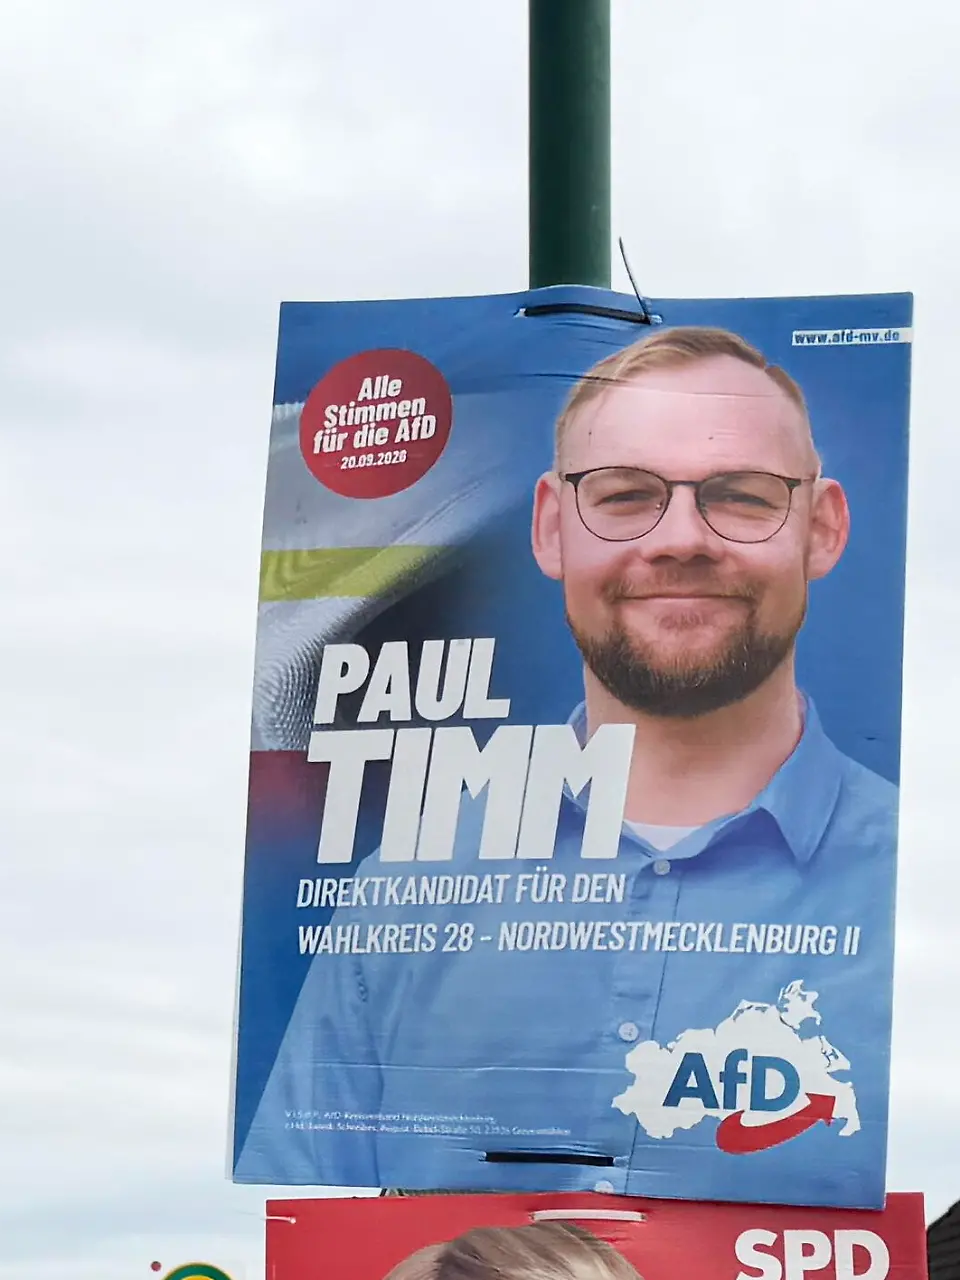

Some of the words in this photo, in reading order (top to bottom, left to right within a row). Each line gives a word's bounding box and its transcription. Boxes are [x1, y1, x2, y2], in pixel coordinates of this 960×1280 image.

[358, 374, 402, 401] Alle
[323, 397, 426, 429] Stimmen
[313, 428, 349, 454] für
[353, 423, 389, 448] die
[394, 414, 437, 443] AfD
[313, 637, 511, 725] PAUL
[307, 723, 637, 864] TIMM
[296, 874, 511, 907] DIREKTKANDIDAT
[515, 866, 567, 903] FÜR
[571, 873, 626, 903] DEN
[298, 923, 438, 954] WAHLKREIS
[442, 923, 475, 952] 28
[498, 921, 839, 955] NORDWESTMECKLENBURG
[843, 926, 861, 955] II
[662, 1048, 801, 1112] AfD
